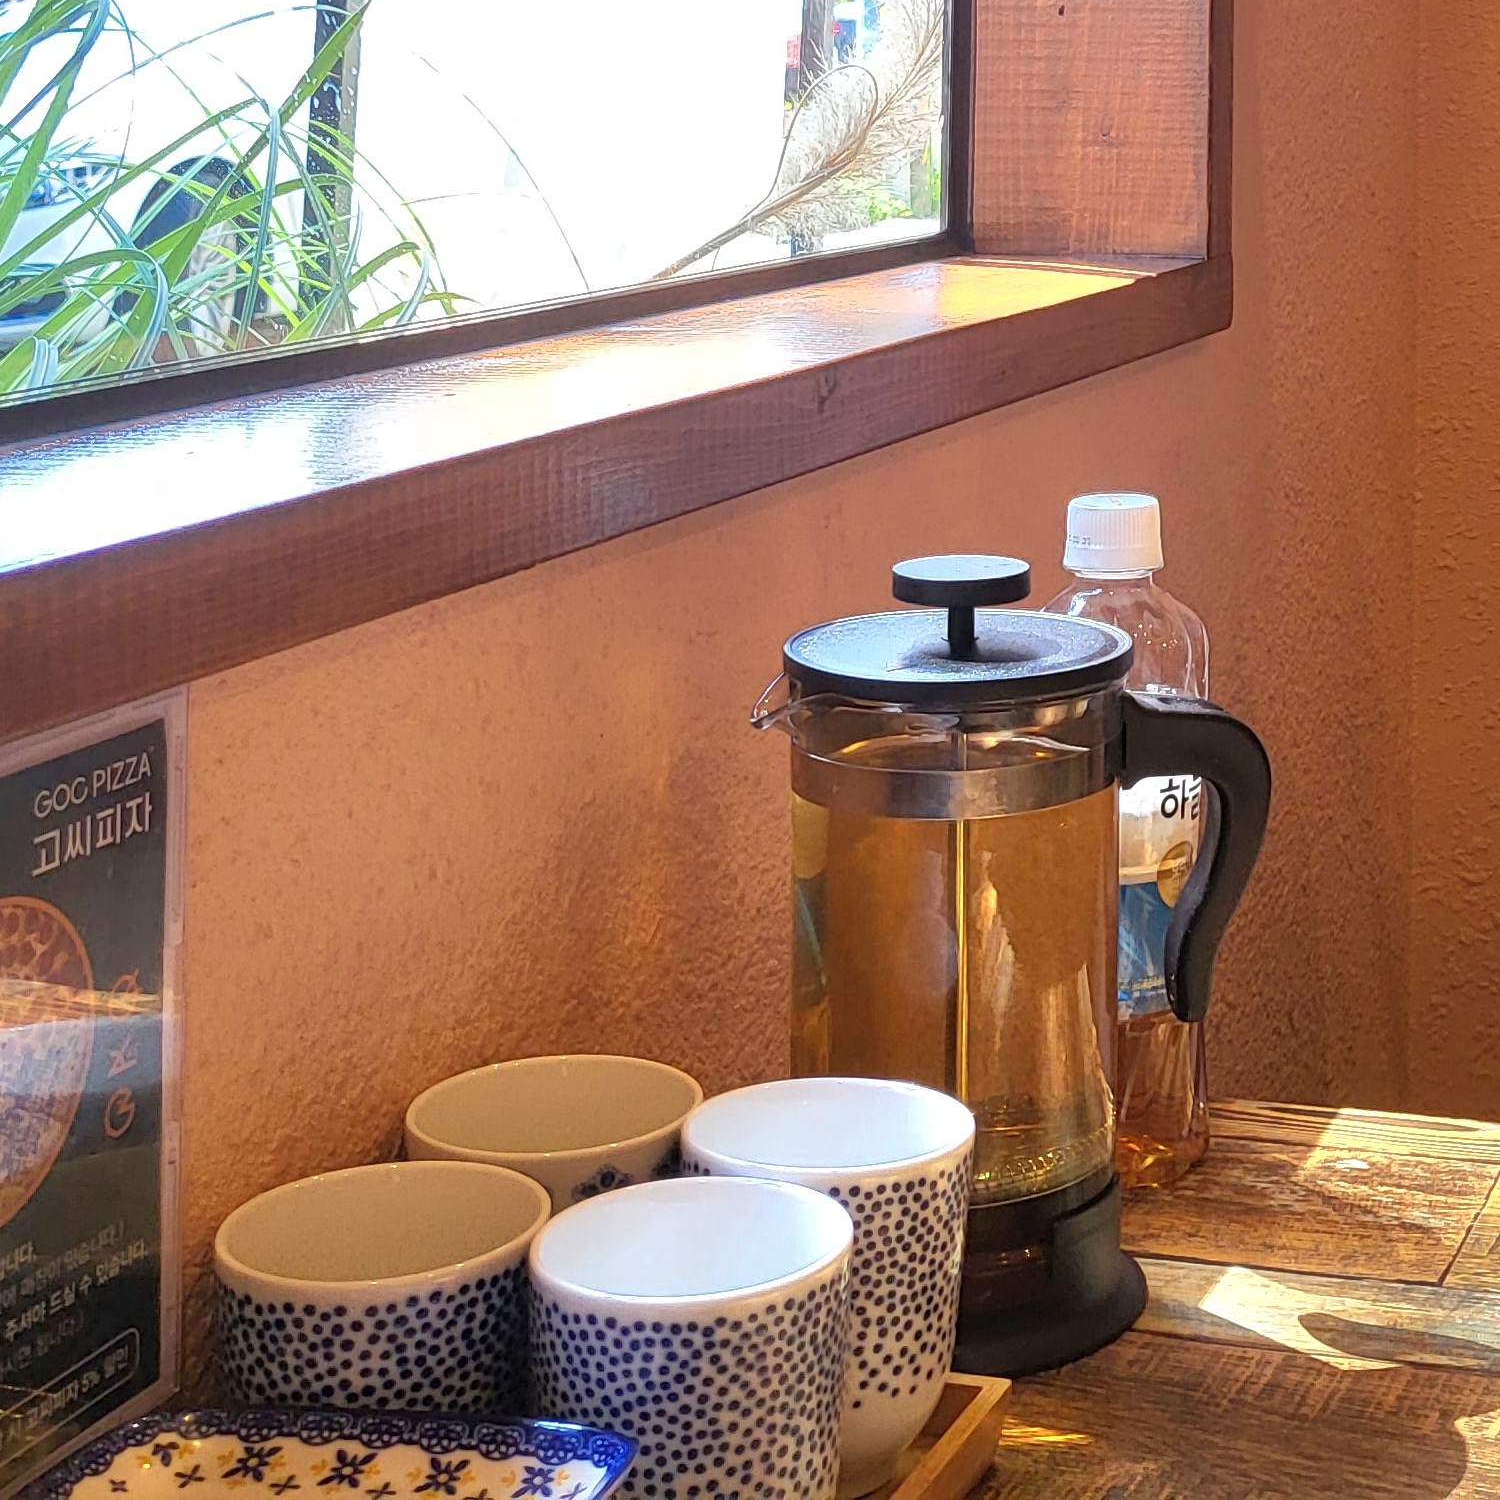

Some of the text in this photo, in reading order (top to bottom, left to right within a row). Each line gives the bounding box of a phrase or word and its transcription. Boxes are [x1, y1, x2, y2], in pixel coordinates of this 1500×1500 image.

[92, 752, 152, 799] PIZZA
[32, 791, 153, 877] 고씨피자
[49, 1281, 76, 1316] 드실
[79, 1273, 93, 1296] 수
